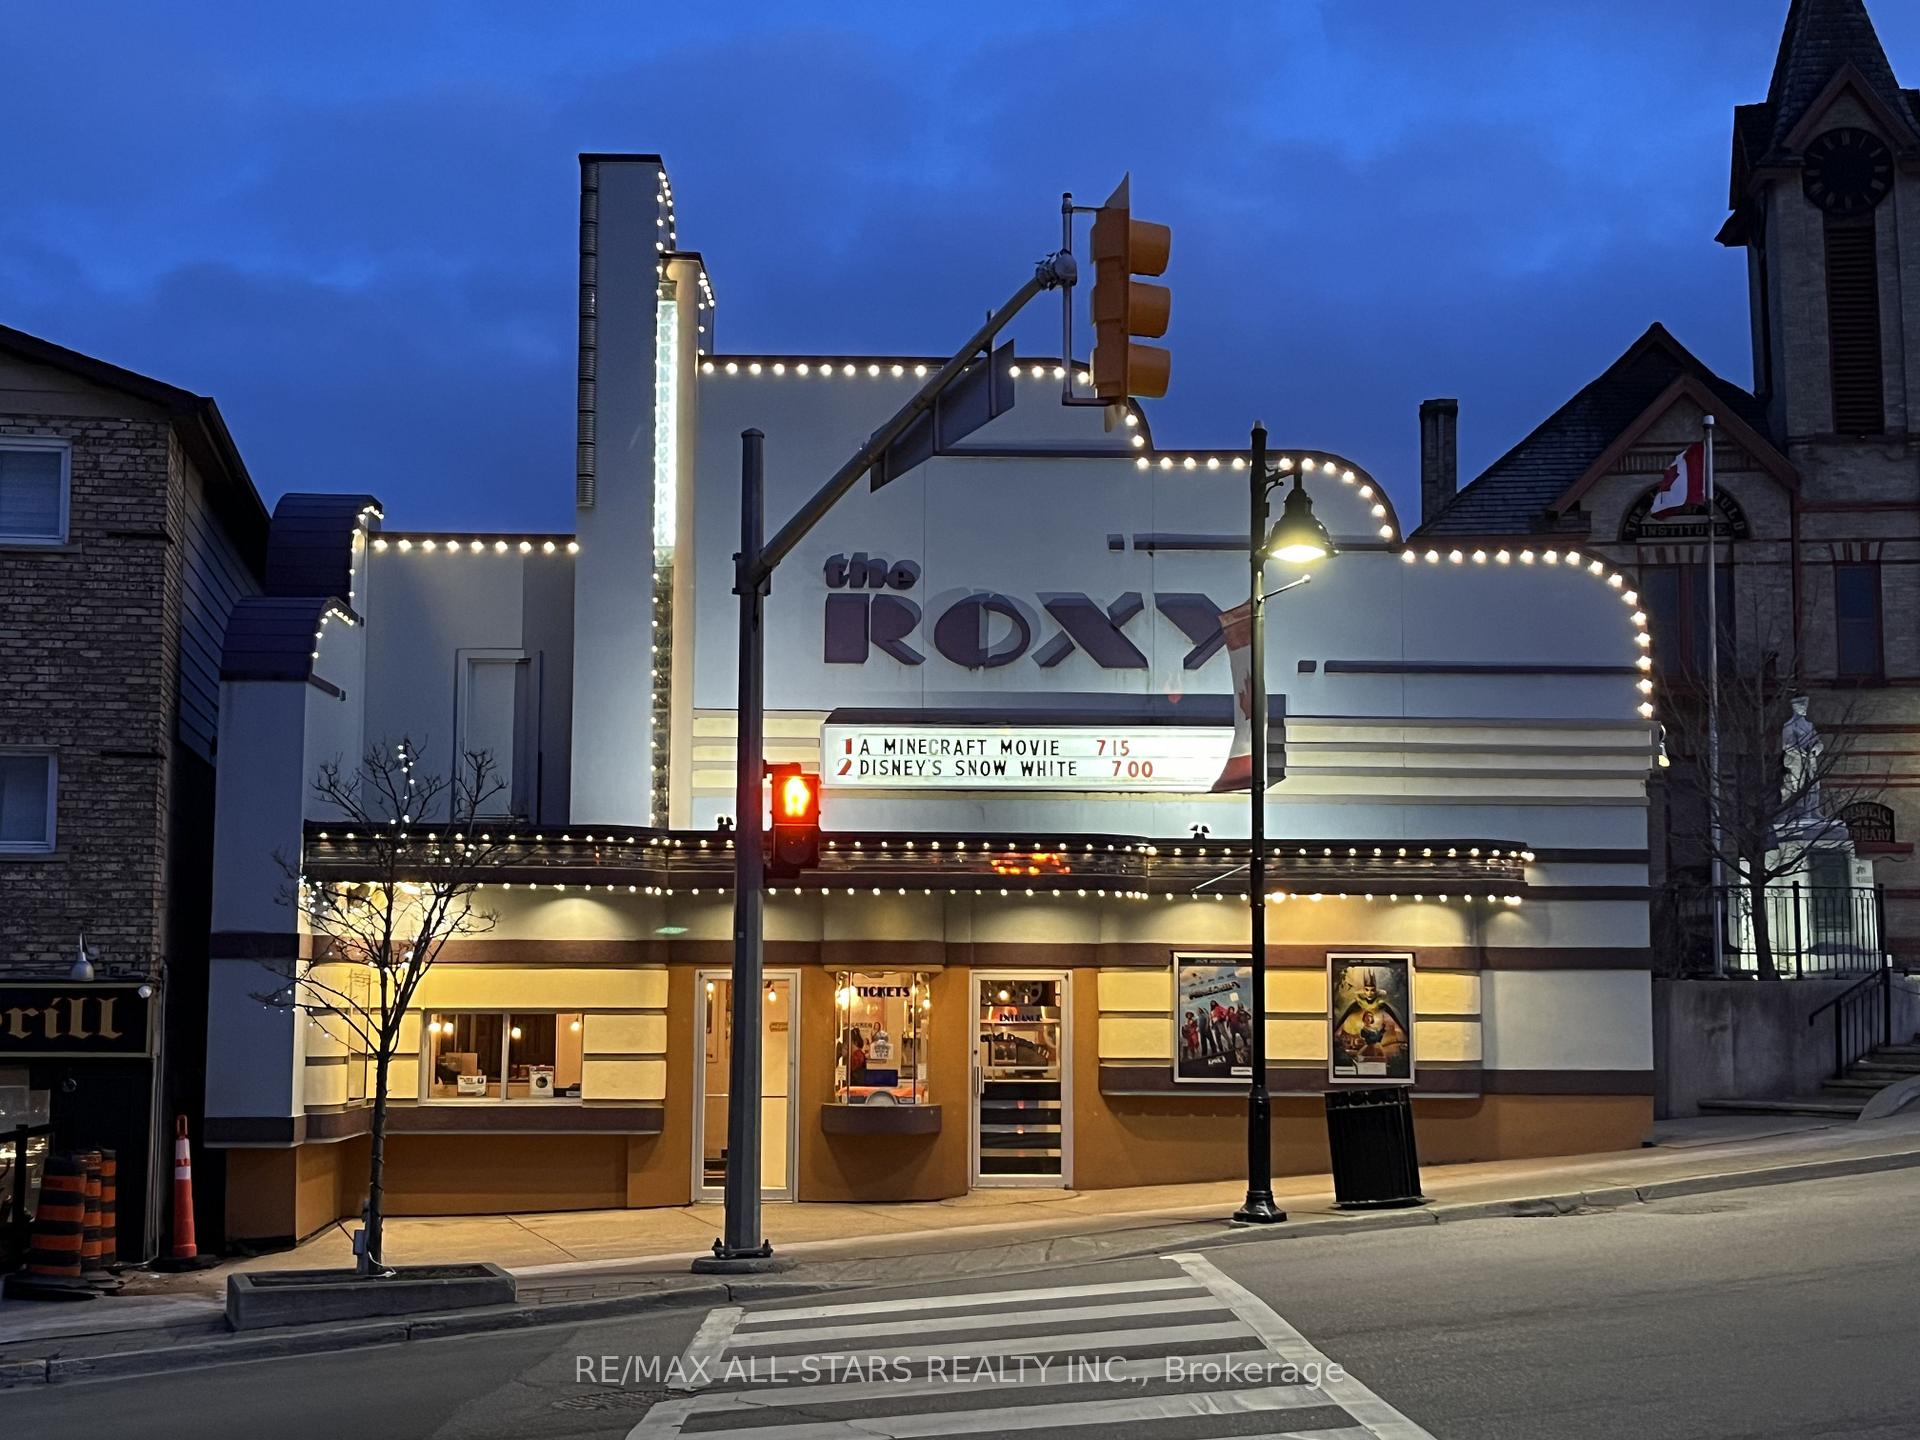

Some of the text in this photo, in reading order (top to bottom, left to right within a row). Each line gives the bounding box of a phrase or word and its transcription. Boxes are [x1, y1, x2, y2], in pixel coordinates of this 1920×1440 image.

[824, 552, 921, 590] the
[824, 592, 1230, 669] ROXY
[842, 738, 1130, 756] 1 A MINECRAFT MOVIE 715
[837, 758, 1154, 778] 2 DISNEY'S SNOW WHITE 700
[1849, 826, 1892, 841] IBRARY
[856, 986, 911, 998] TICKETS
[0, 997, 123, 1039] rill
